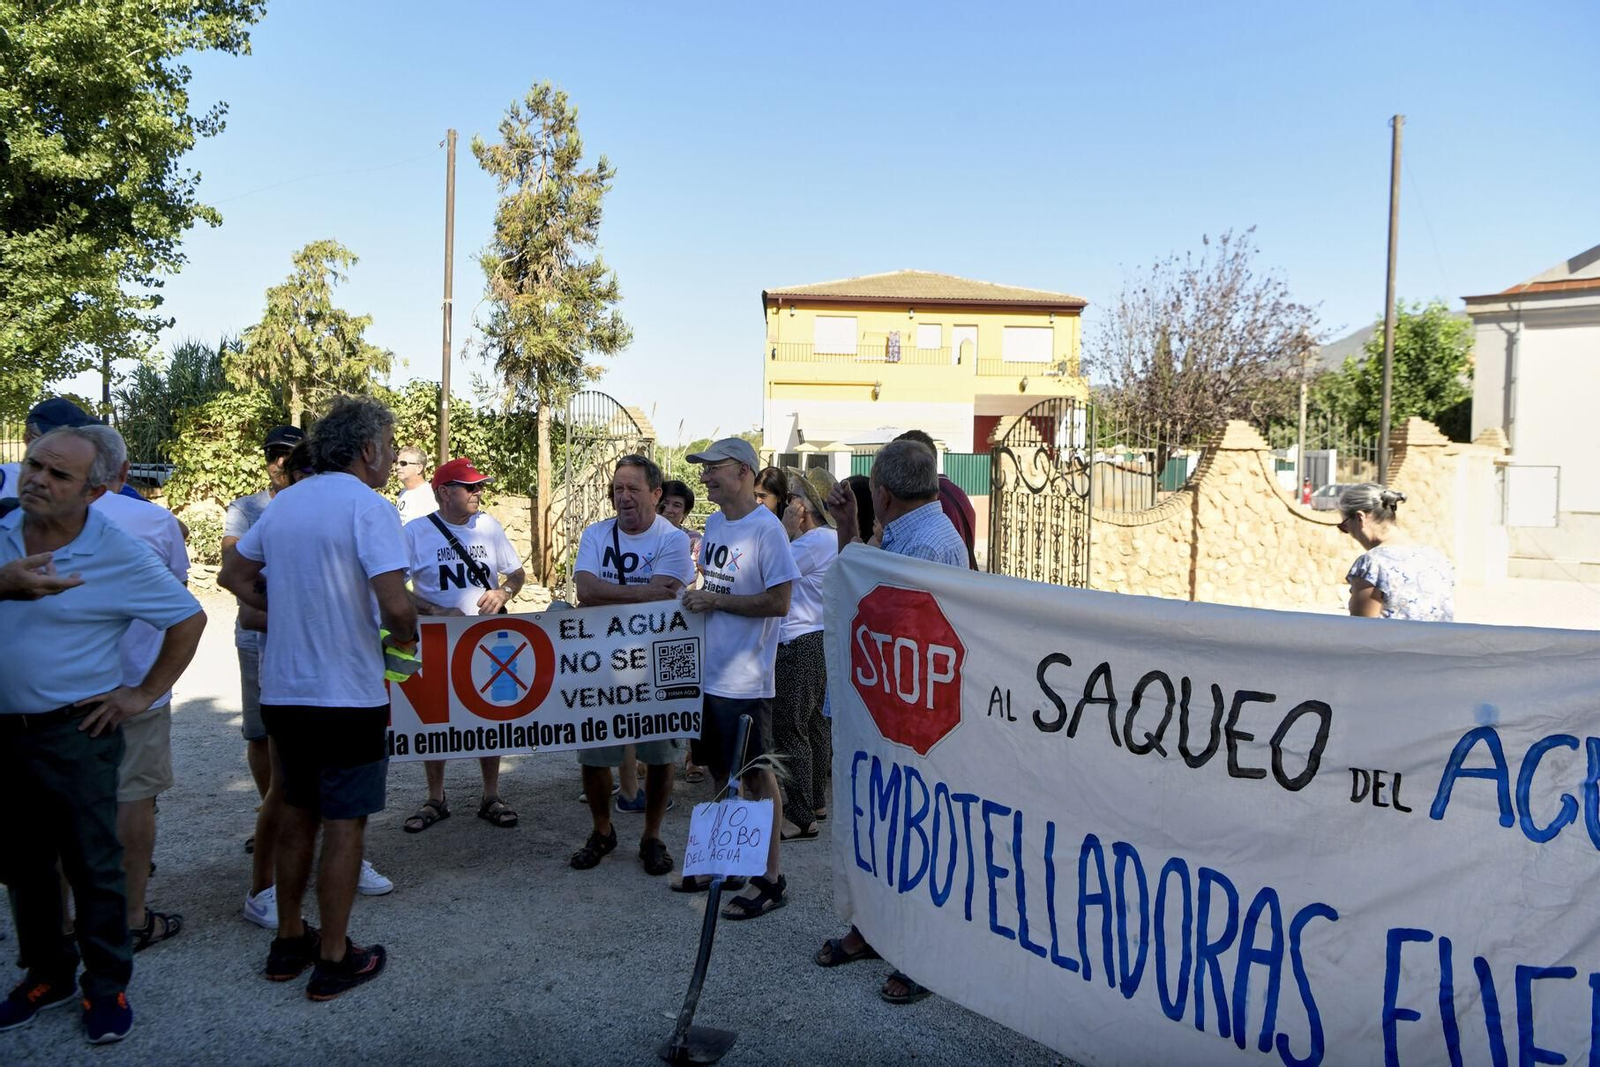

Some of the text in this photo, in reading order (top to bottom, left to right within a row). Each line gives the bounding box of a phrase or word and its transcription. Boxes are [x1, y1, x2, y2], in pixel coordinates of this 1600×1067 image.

[559, 610, 689, 640] EL AGUA
[385, 617, 555, 727] NO
[560, 647, 648, 674] NO SE
[856, 624, 957, 710] STOP
[560, 682, 652, 709] VENDE
[388, 711, 700, 756] la embotelladora de Cijancos
[987, 685, 1018, 722] AL
[1032, 652, 1332, 791] SAQUEO
[1349, 767, 1412, 813] DEL
[710, 804, 748, 831] NO
[688, 826, 761, 849] AL ROBO
[685, 847, 740, 868] DEL AGUA
[851, 751, 1600, 1067] EMBOTELLADORAS FUE
